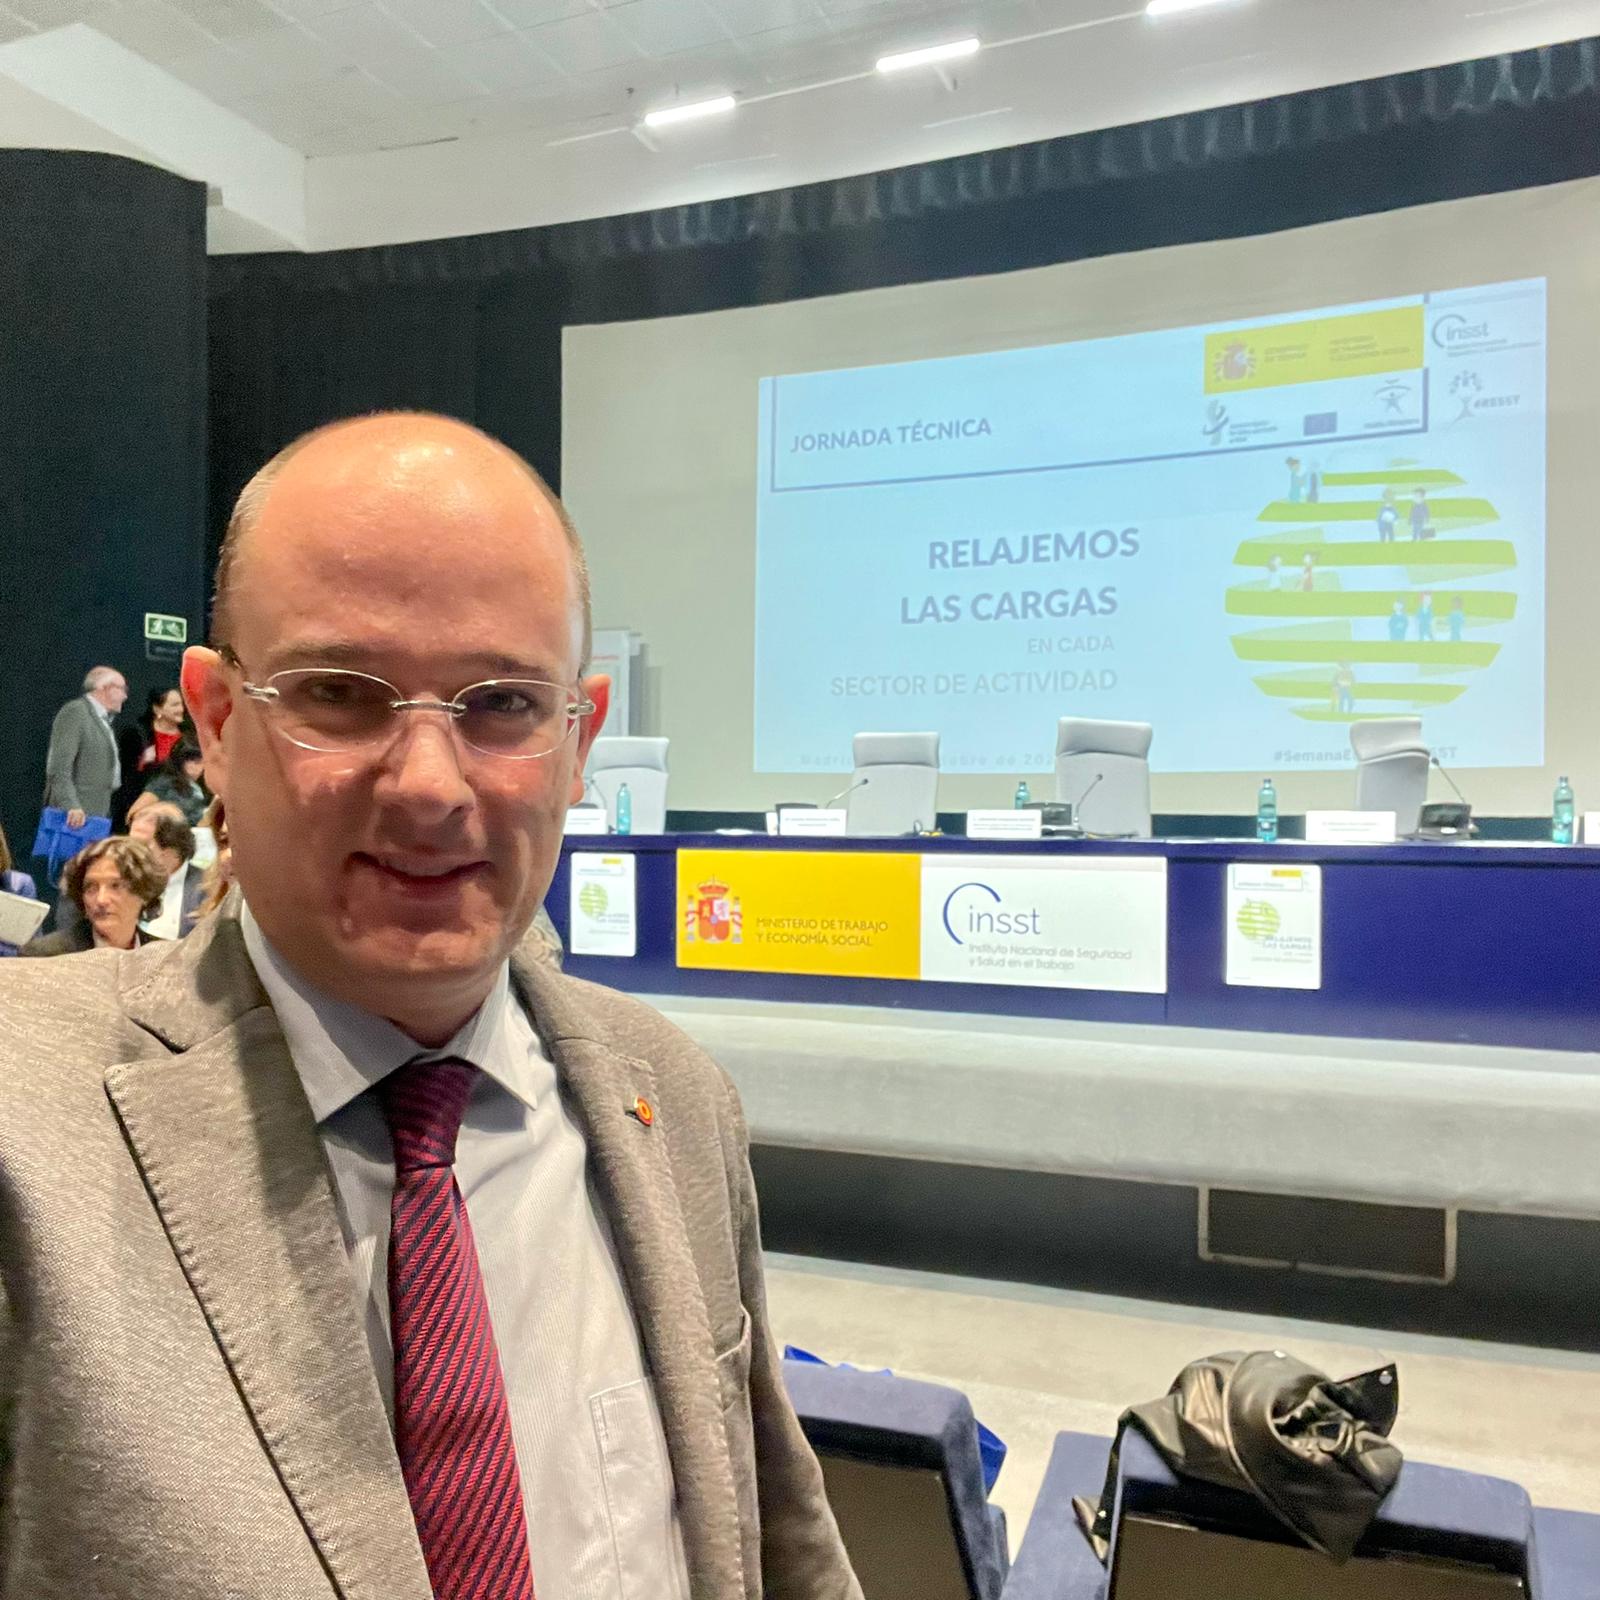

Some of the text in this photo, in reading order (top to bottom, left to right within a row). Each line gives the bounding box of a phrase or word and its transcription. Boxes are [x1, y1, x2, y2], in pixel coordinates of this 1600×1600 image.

[791, 418, 992, 453] JORNADA TÉCNICA
[928, 527, 1140, 569] RELAJEMOS
[900, 586, 1119, 625] LAS CARGAS
[1027, 635, 1115, 654] EN CADA
[830, 668, 1118, 697] SECTOR DE ACTIVIDAD
[756, 917, 889, 933] MINISTERIO DE TRABAJO
[968, 904, 1041, 935] insst
[756, 931, 873, 946] Y ECONOMÍA SOCIAL
[968, 943, 1132, 961] Instituto Nacional de Seguridad
[977, 956, 1005, 968] Salud
[1007, 959, 1021, 968] en
[1023, 958, 1033, 968] el
[1036, 958, 1075, 971] Trabajo
